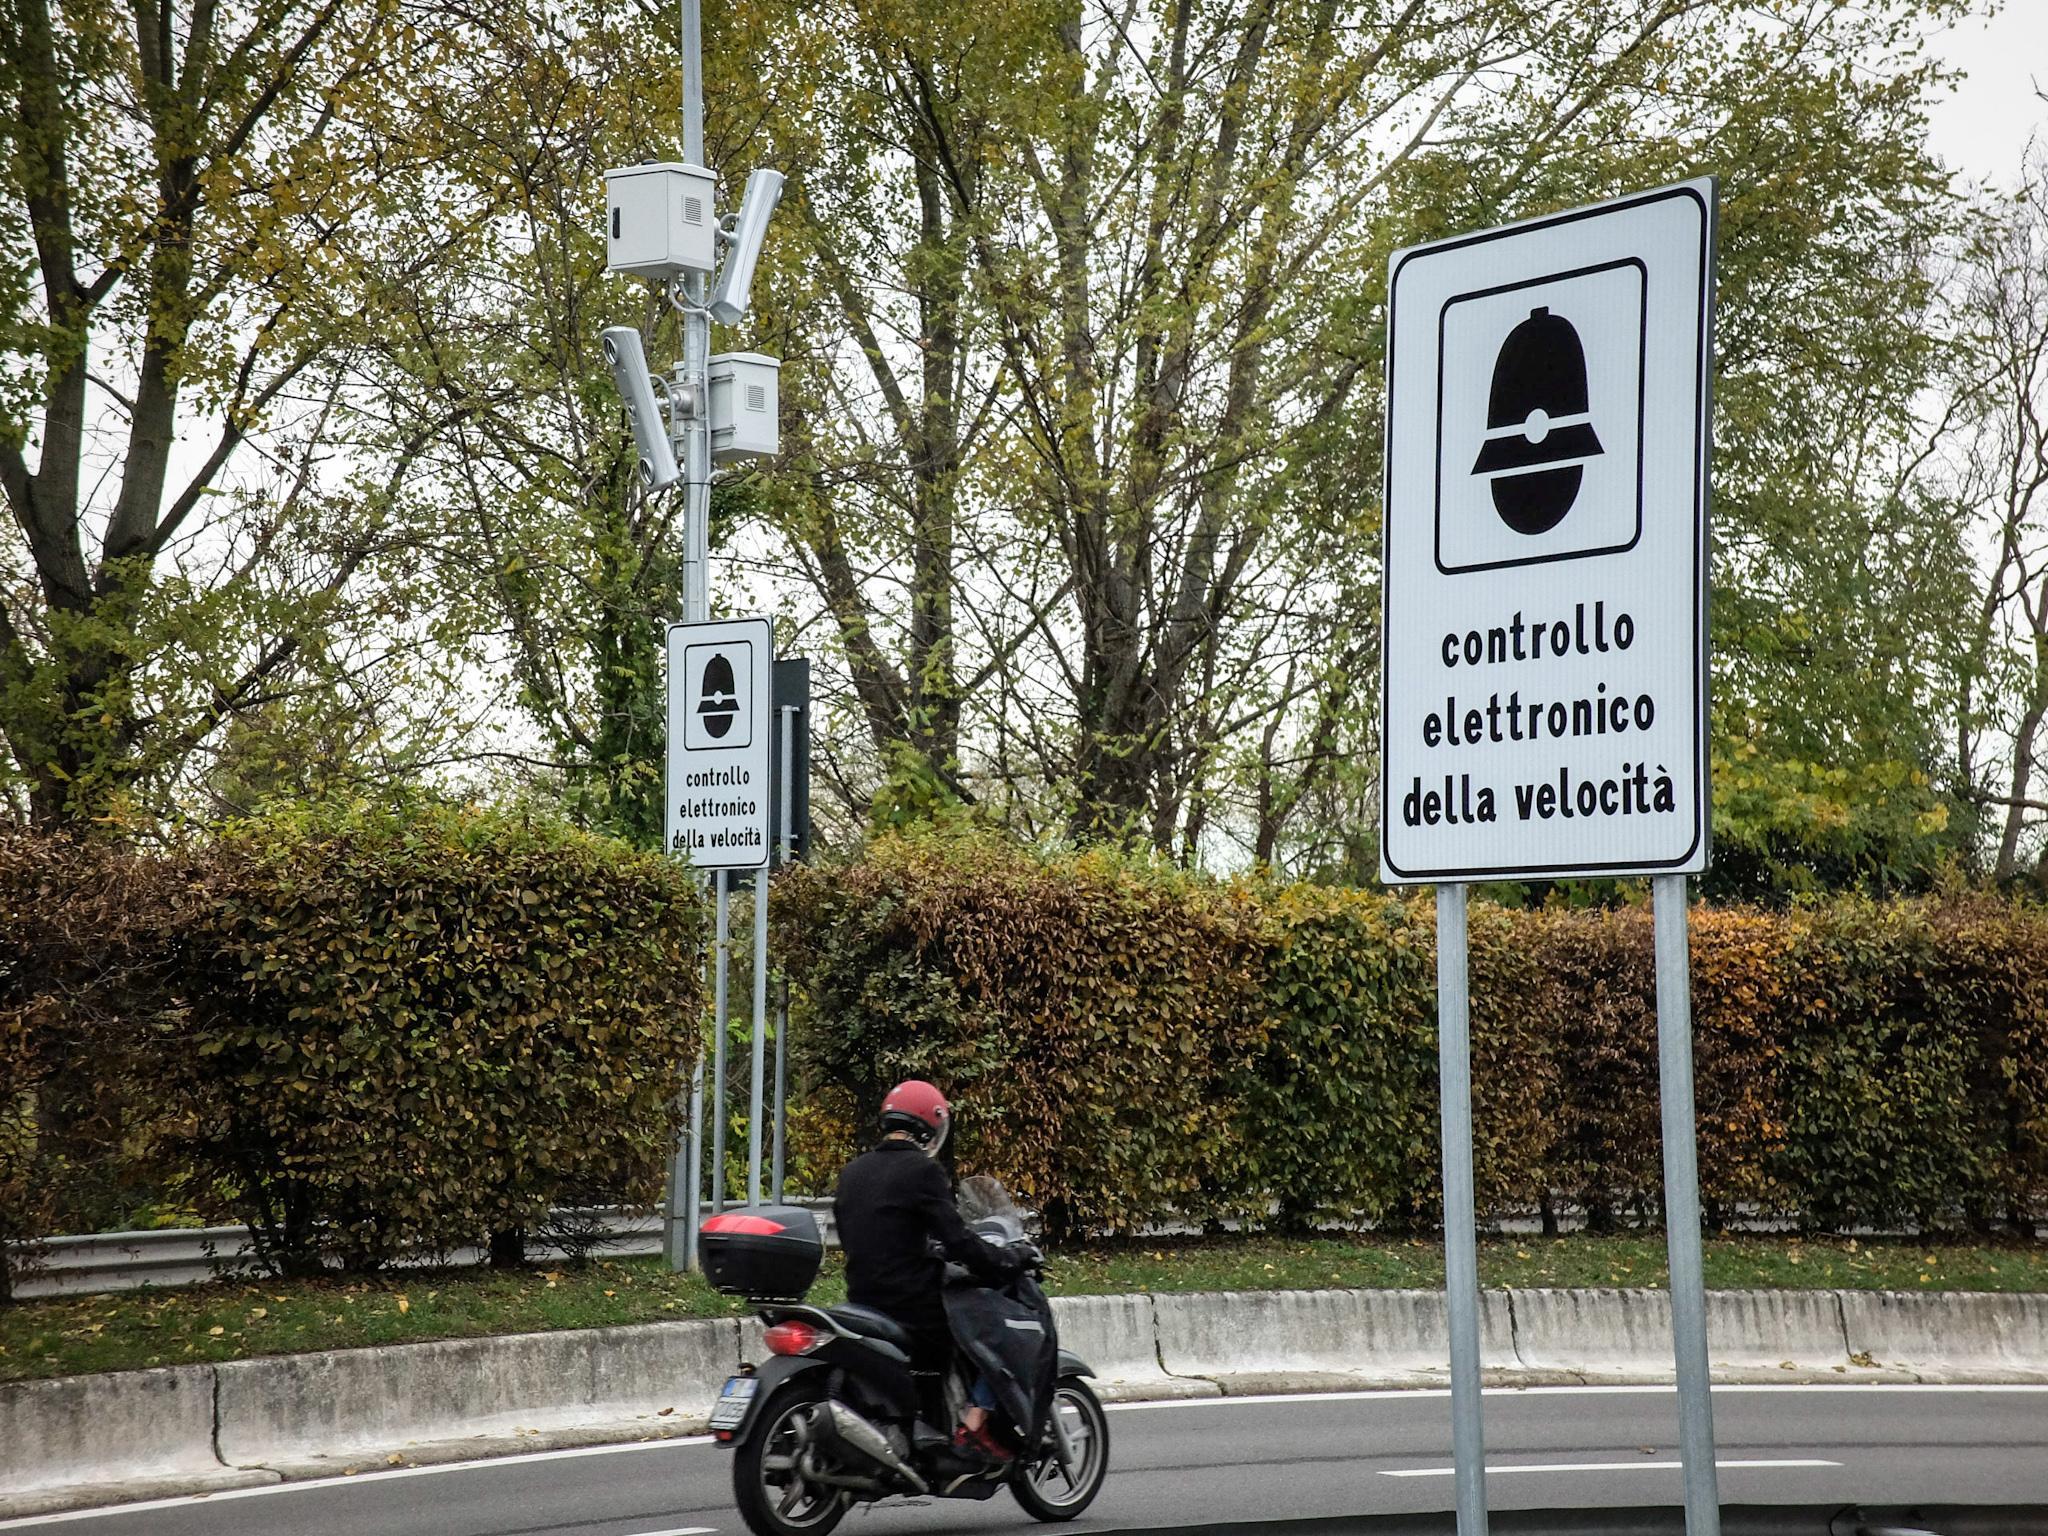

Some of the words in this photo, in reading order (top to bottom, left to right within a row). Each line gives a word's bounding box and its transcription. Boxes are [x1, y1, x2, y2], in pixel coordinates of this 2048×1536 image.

[1441, 600, 1635, 668] controllo
[1423, 682, 1655, 748] elettronico
[686, 765, 750, 788] controllo
[1403, 773, 1497, 827] della
[1514, 761, 1676, 821] velocità
[679, 796, 756, 818] elettronico
[672, 828, 705, 849] della
[710, 826, 761, 848] velocità
